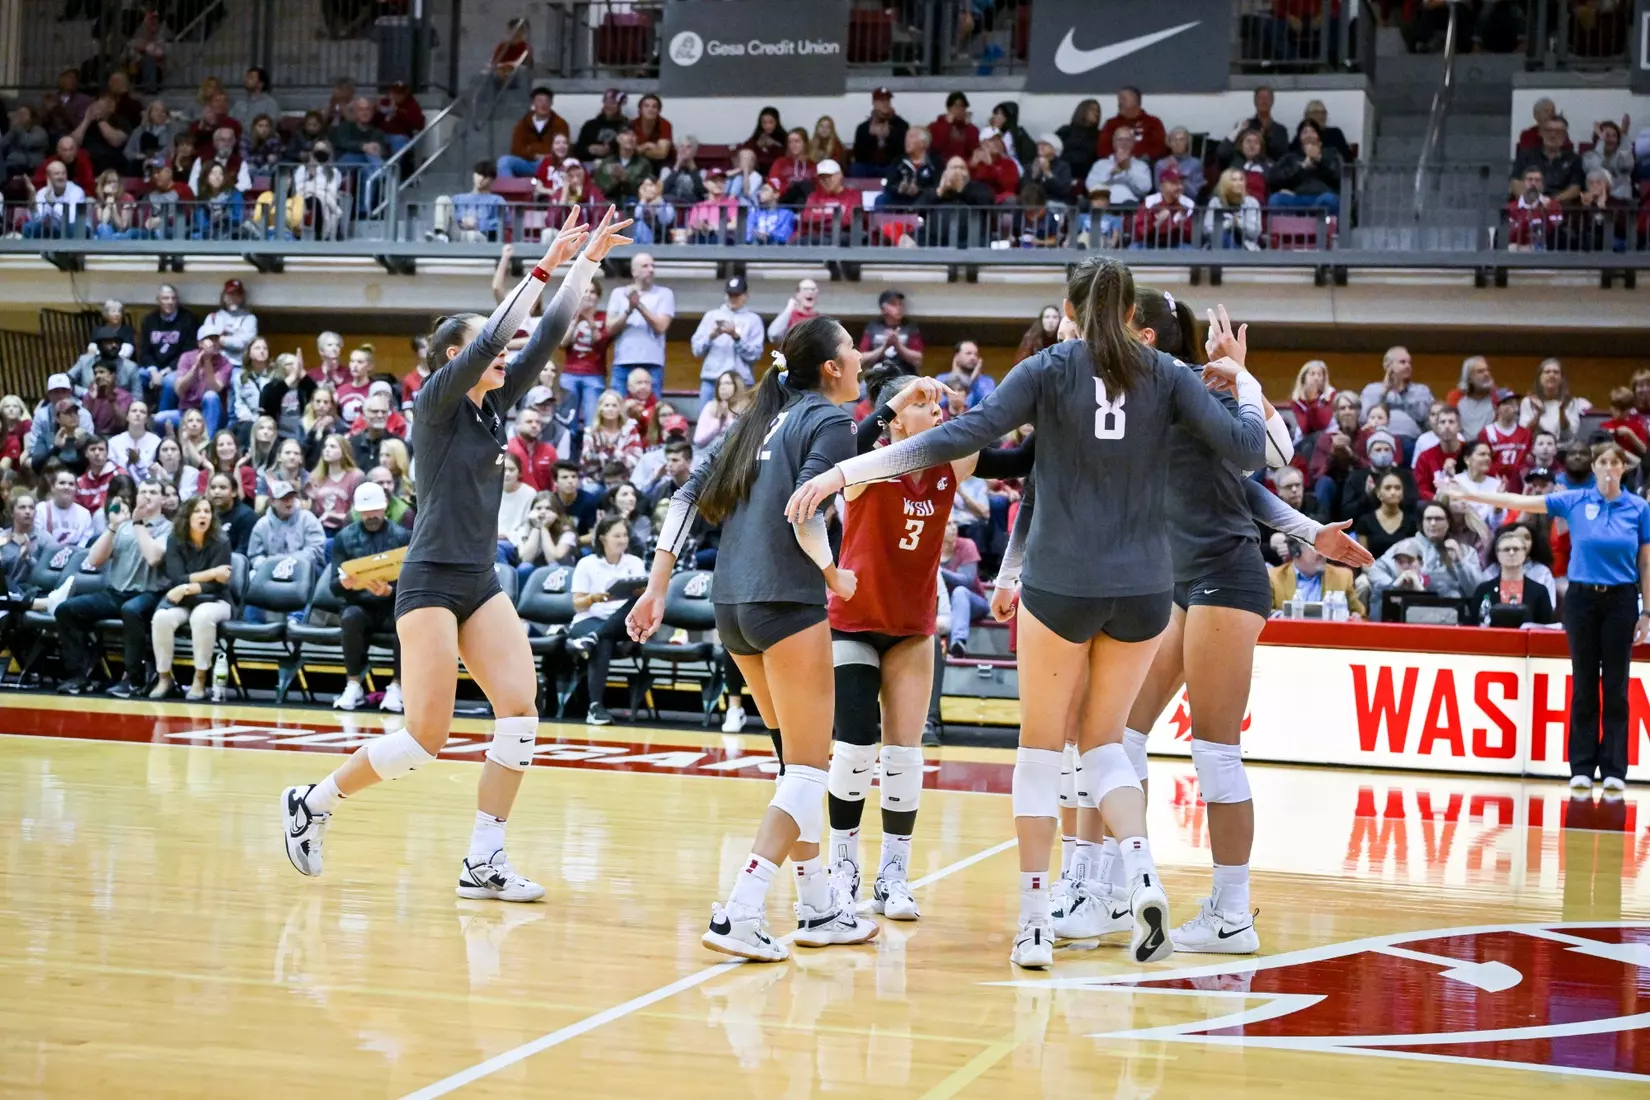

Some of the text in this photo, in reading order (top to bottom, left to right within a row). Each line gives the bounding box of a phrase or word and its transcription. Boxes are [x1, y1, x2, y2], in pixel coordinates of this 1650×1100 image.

[707, 40, 840, 56] Gesa Credit Union
[1092, 376, 1126, 440] 8
[903, 497, 935, 517] WSU
[899, 519, 925, 551] 3
[1349, 664, 1650, 766] WASH
